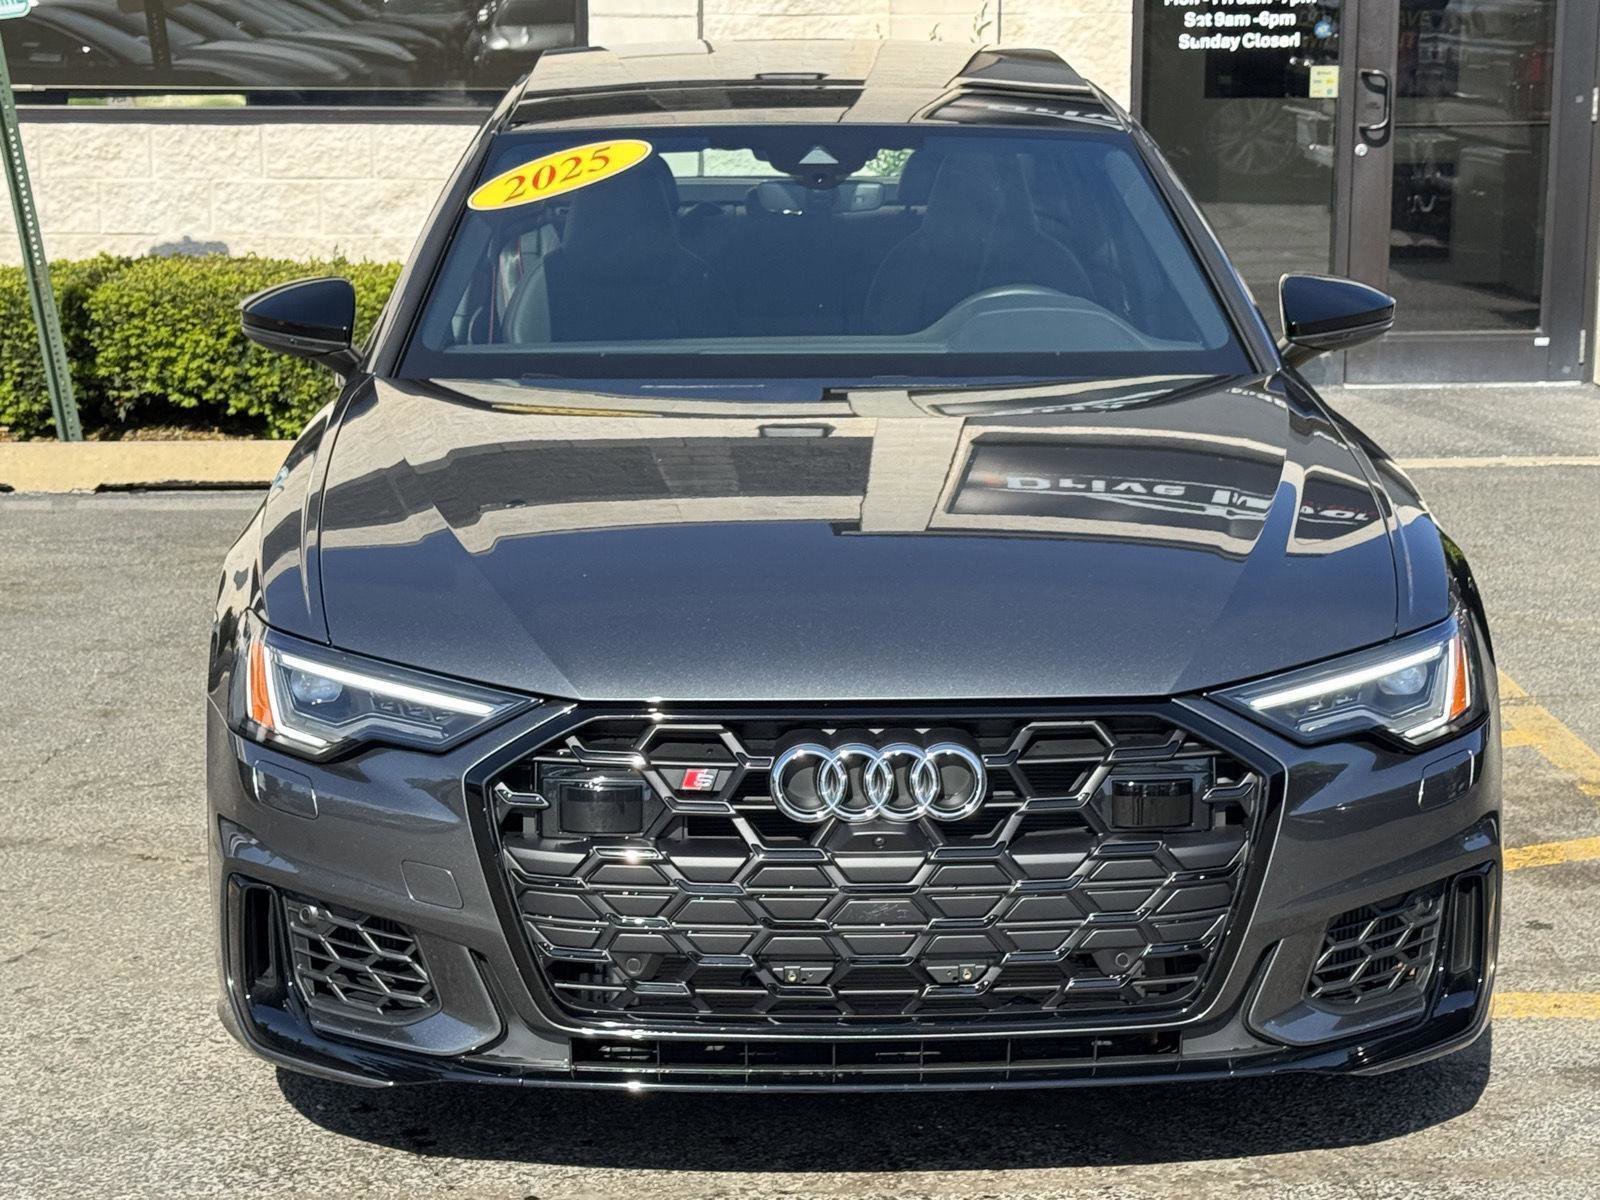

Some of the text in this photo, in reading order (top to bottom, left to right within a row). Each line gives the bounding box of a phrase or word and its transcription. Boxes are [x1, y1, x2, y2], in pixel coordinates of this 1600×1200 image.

[1184, 11, 1213, 27] Sat
[1214, 11, 1251, 27] 9am
[1178, 32, 1301, 52] Sunday Closed
[504, 147, 611, 202] 2025
